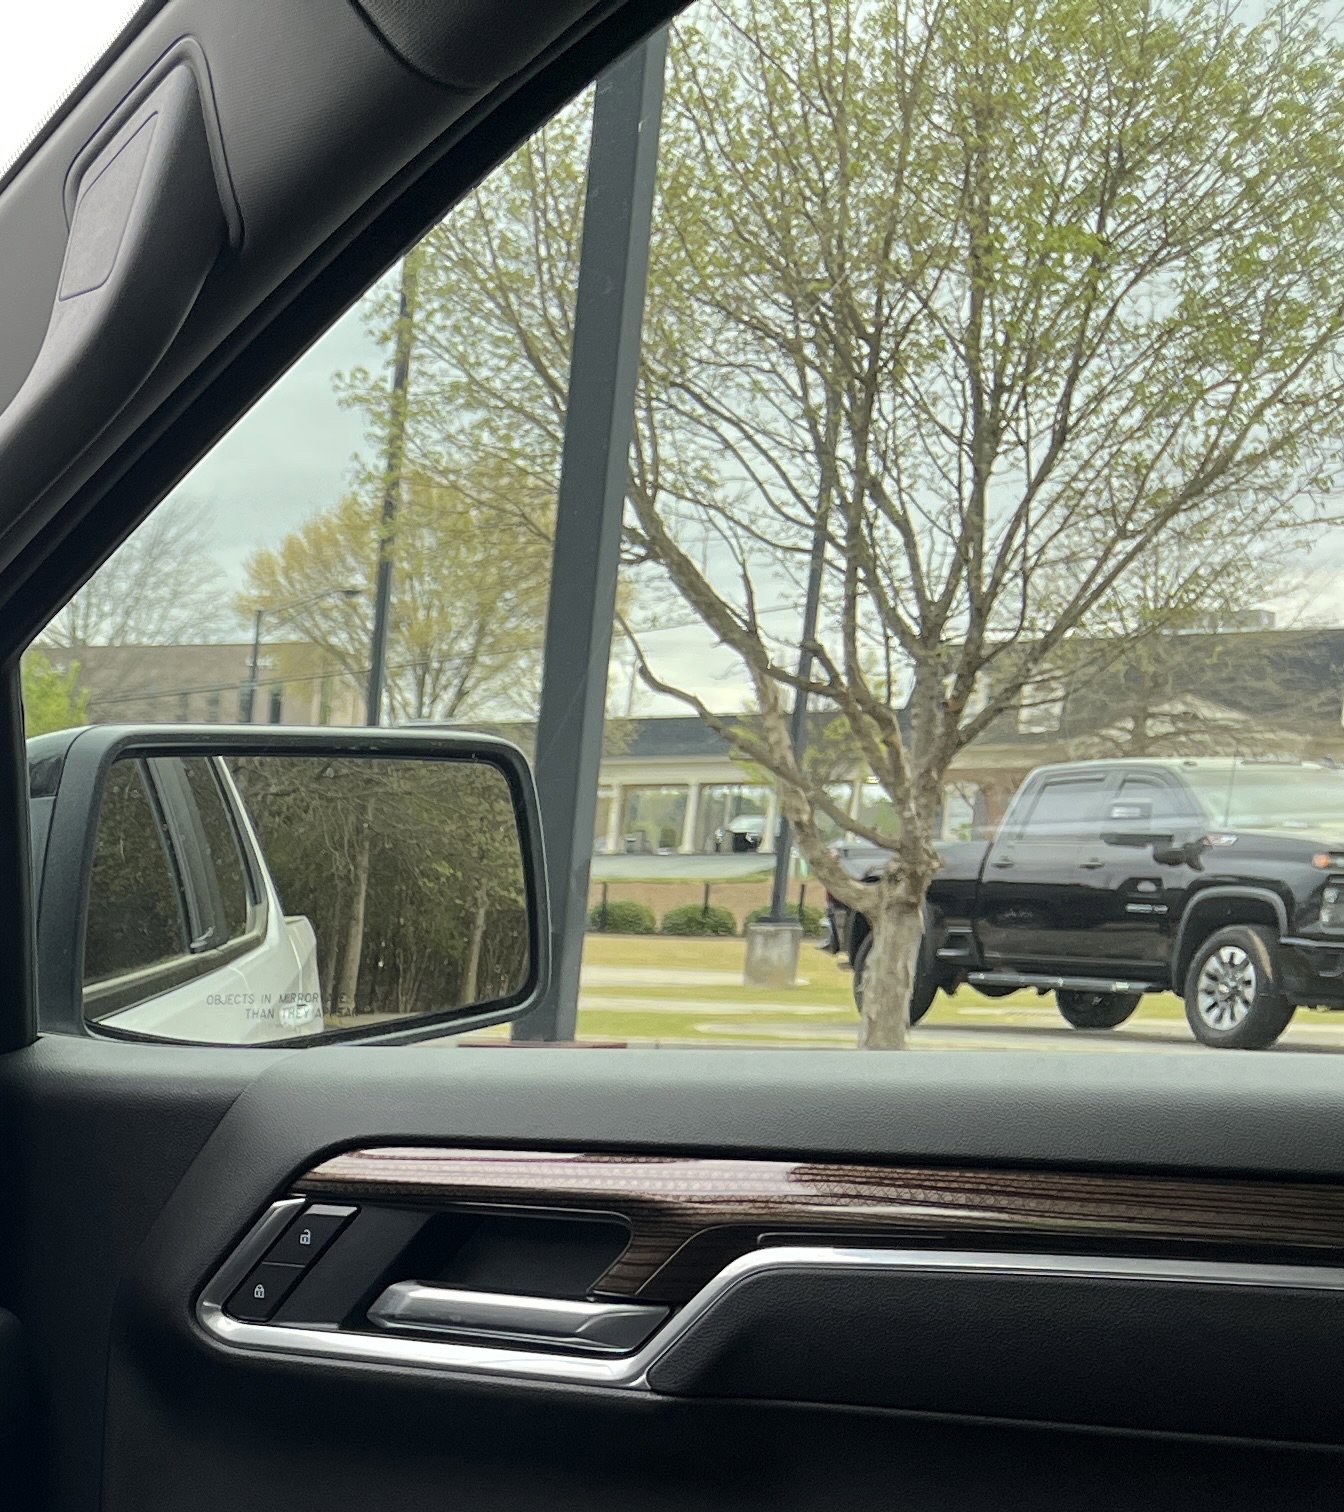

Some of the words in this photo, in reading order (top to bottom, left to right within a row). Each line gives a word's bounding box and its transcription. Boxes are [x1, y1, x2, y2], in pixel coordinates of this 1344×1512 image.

[206, 993, 255, 1005] OBJECTS
[261, 993, 272, 1004] IN
[279, 992, 319, 1004] MIRROR
[245, 1008, 275, 1020] THAN
[282, 1007, 310, 1019] THEY
